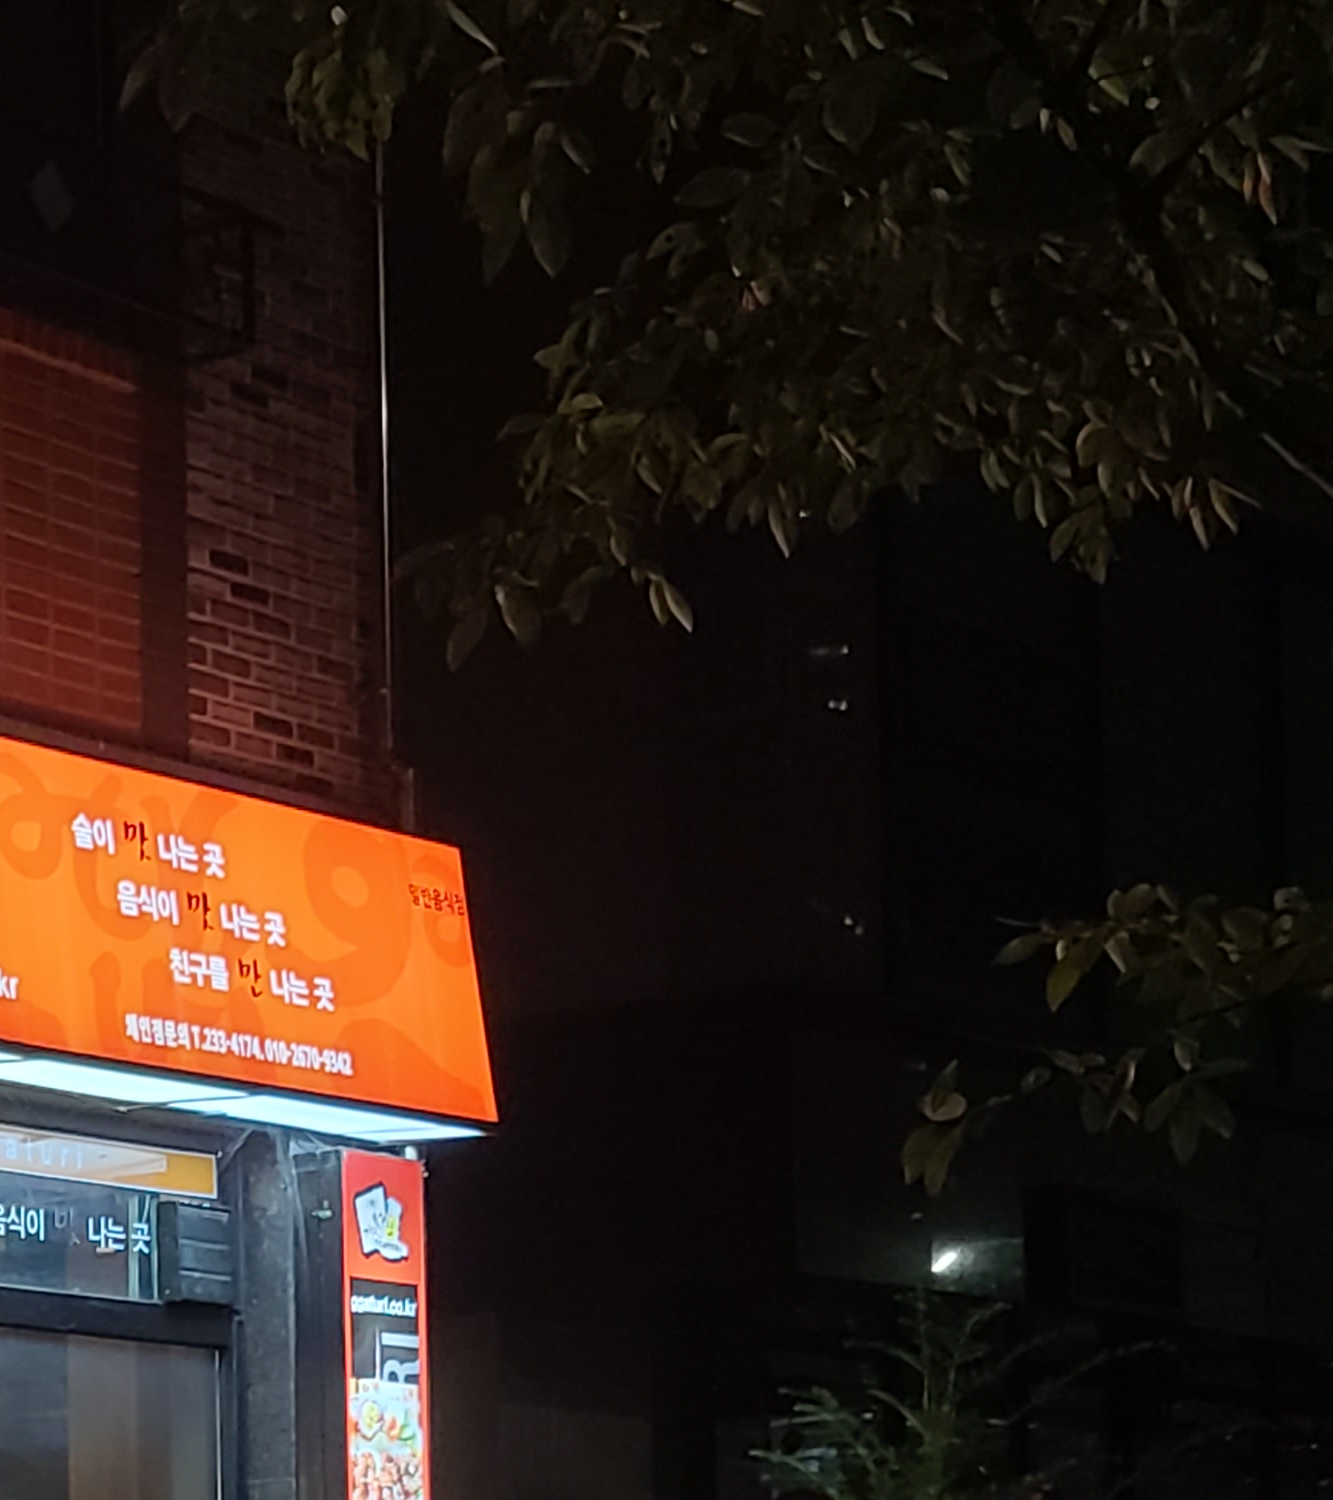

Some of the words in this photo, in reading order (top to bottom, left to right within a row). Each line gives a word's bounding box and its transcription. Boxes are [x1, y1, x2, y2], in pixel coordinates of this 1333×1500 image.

[72, 813, 115, 854] 술이
[157, 834, 199, 873] 나는
[202, 843, 226, 879] 곳
[117, 879, 179, 926] 음식이
[220, 903, 261, 941] 나는
[264, 912, 286, 947] 곳
[169, 947, 229, 992] 친구를
[269, 969, 310, 1007] 나는
[313, 977, 335, 1012] 곳
[87, 1214, 127, 1252] 나는
[130, 1221, 151, 1255] 곳
